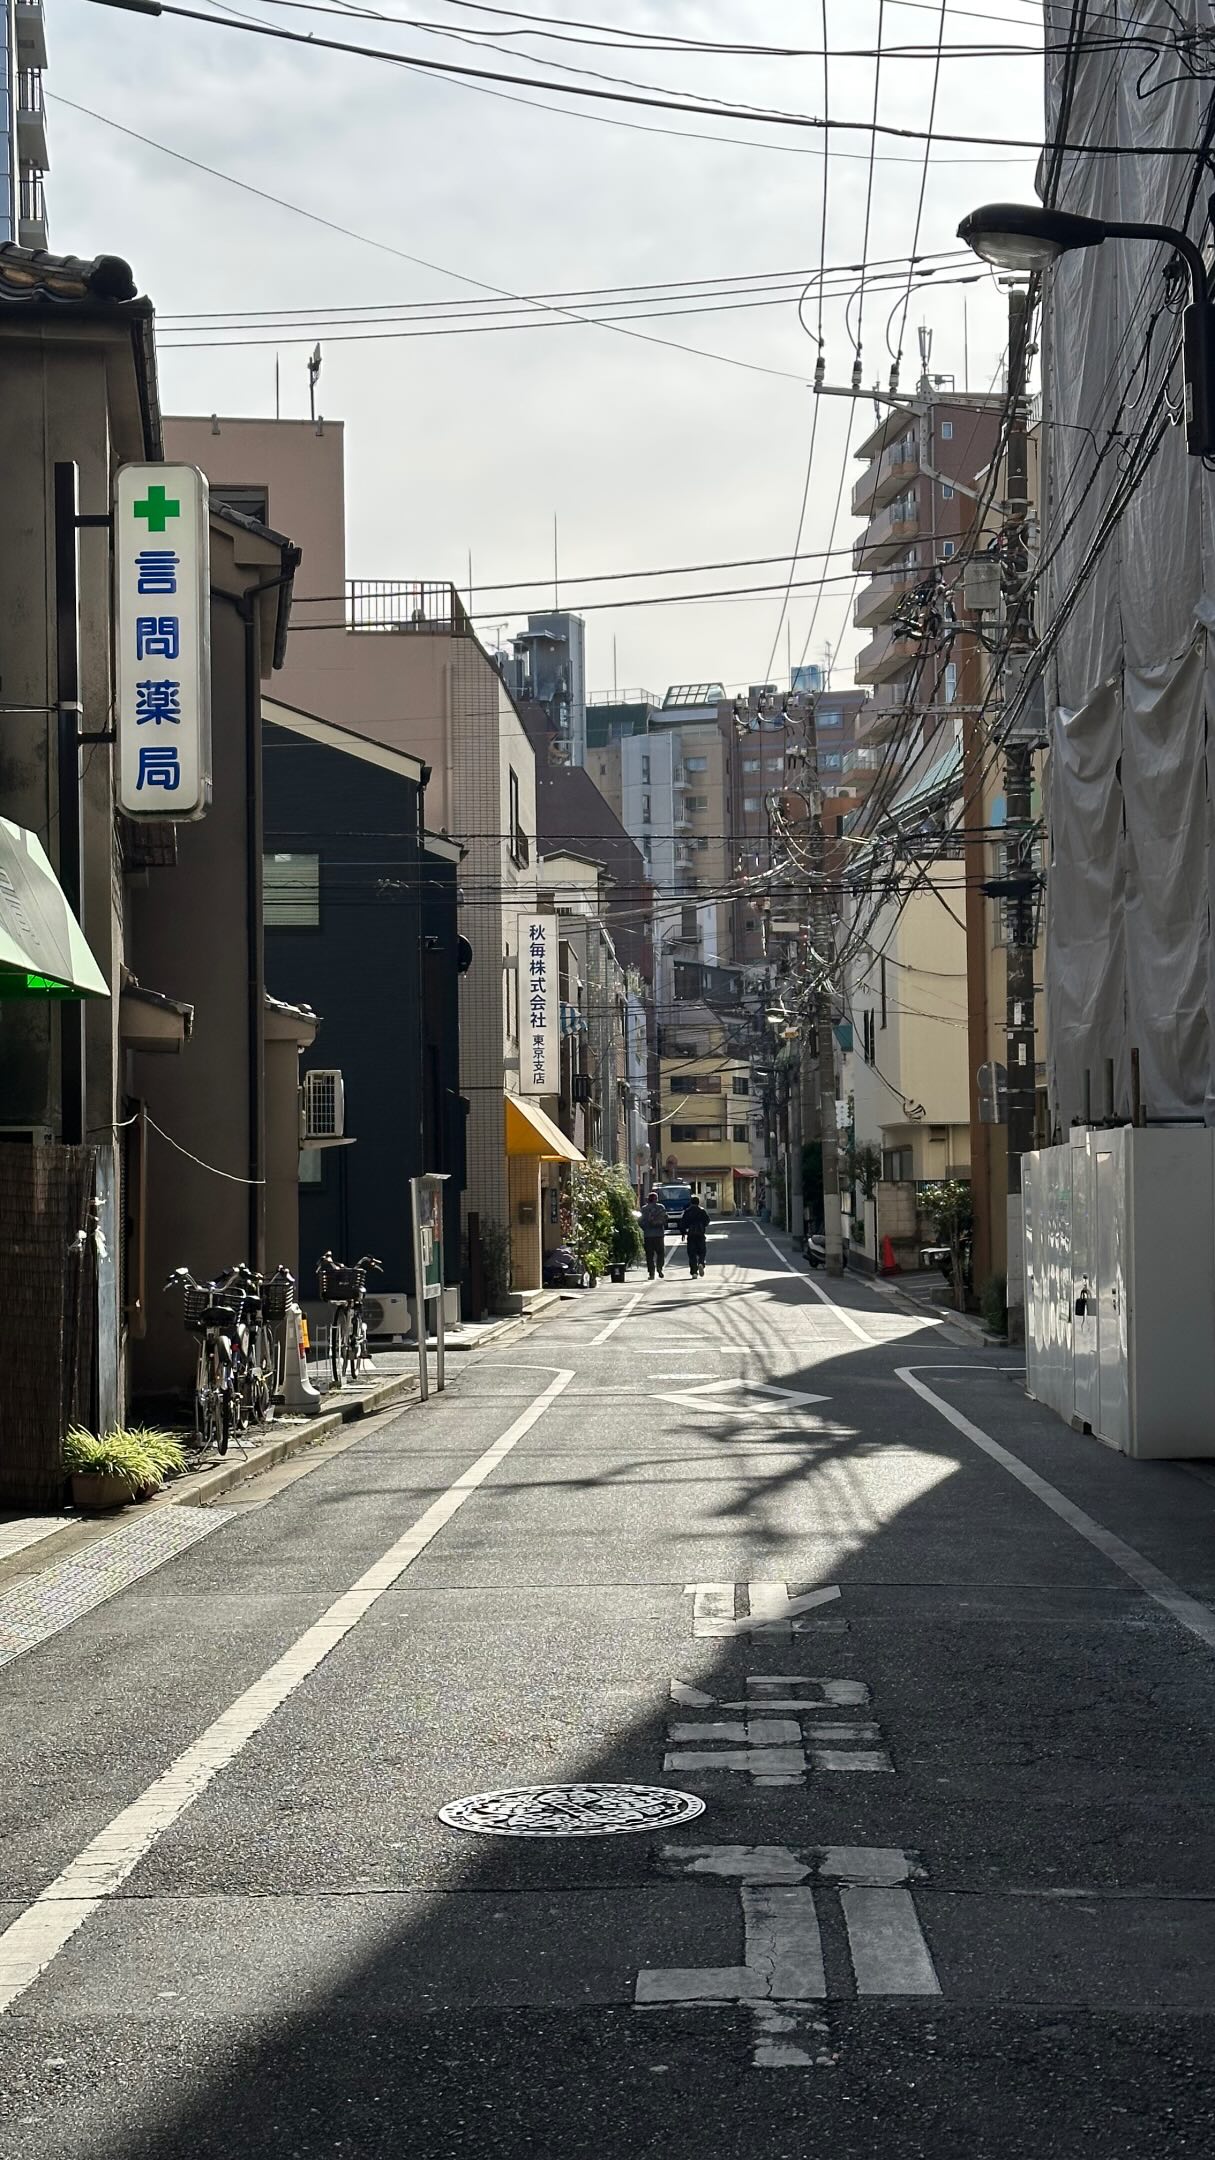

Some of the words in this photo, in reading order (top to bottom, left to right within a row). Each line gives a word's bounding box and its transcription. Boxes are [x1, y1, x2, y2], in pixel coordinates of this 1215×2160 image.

[134, 550, 180, 790] 言問薬局
[529, 924, 546, 1027] 秋毎株式会社
[532, 1034, 544, 1084] 東京支店
